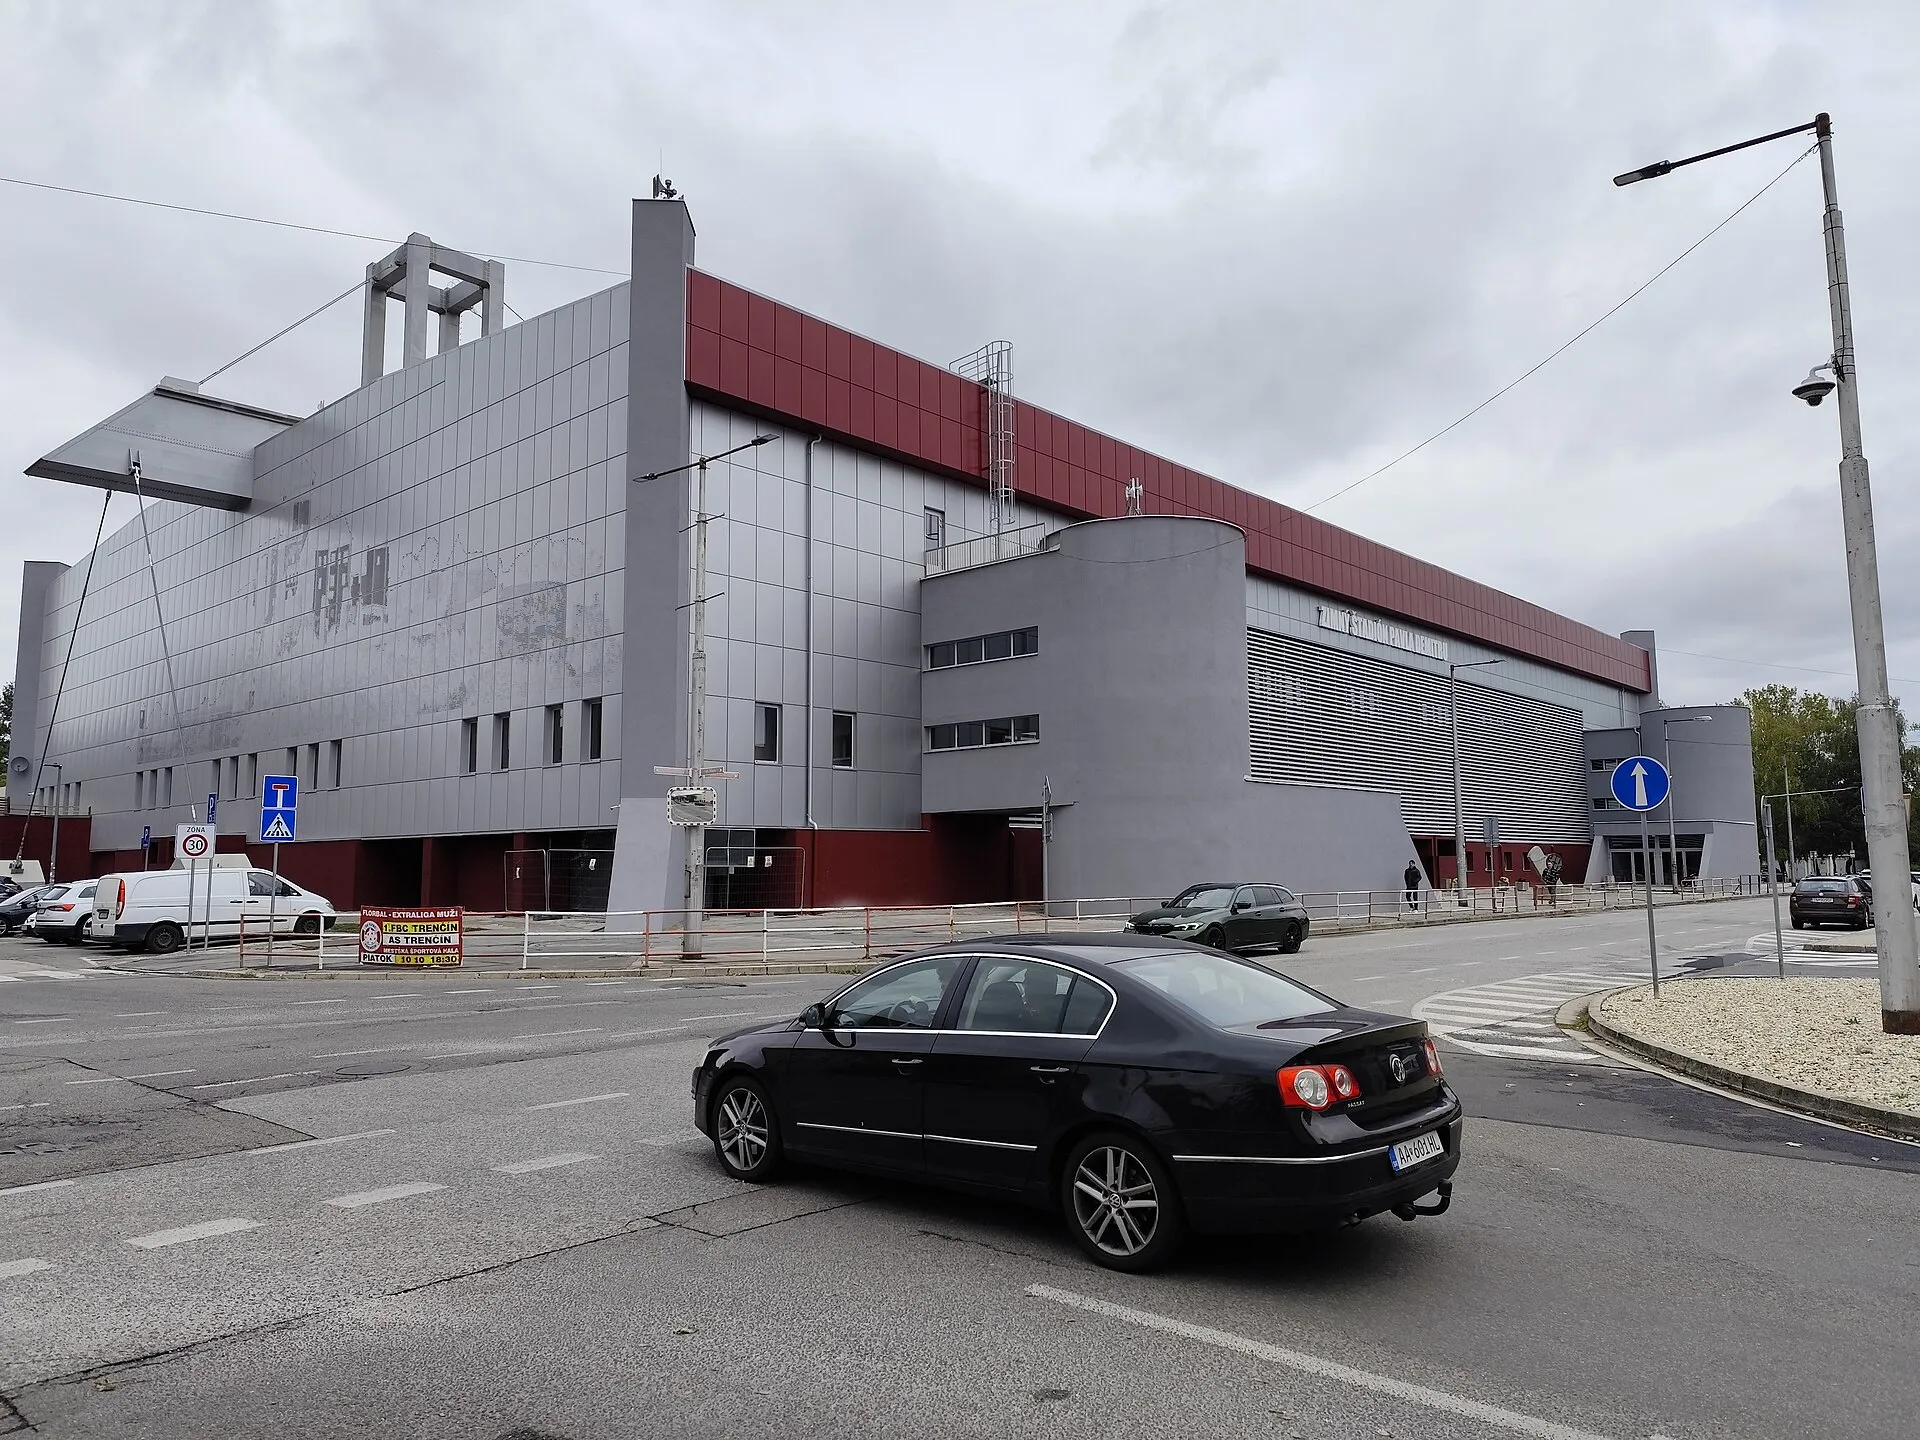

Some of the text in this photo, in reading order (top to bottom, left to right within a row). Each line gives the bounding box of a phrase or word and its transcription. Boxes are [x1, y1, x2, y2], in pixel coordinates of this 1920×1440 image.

[1350, 610, 1388, 645] ŠTADIÓN
[1389, 626, 1415, 652] PAVLA
[188, 840, 203, 851] 30
[362, 909, 388, 918] FLORBAL
[392, 911, 435, 919] EXTRALIGA
[437, 909, 457, 918] MUŽI
[383, 924, 409, 933] 1.FBC
[412, 922, 458, 933] TRENČÍN
[388, 934, 452, 944] AS TRENČÍN
[409, 947, 442, 955] ŠPORTOVÁ
[362, 953, 393, 963] PIATOK
[430, 955, 458, 964] 18:30
